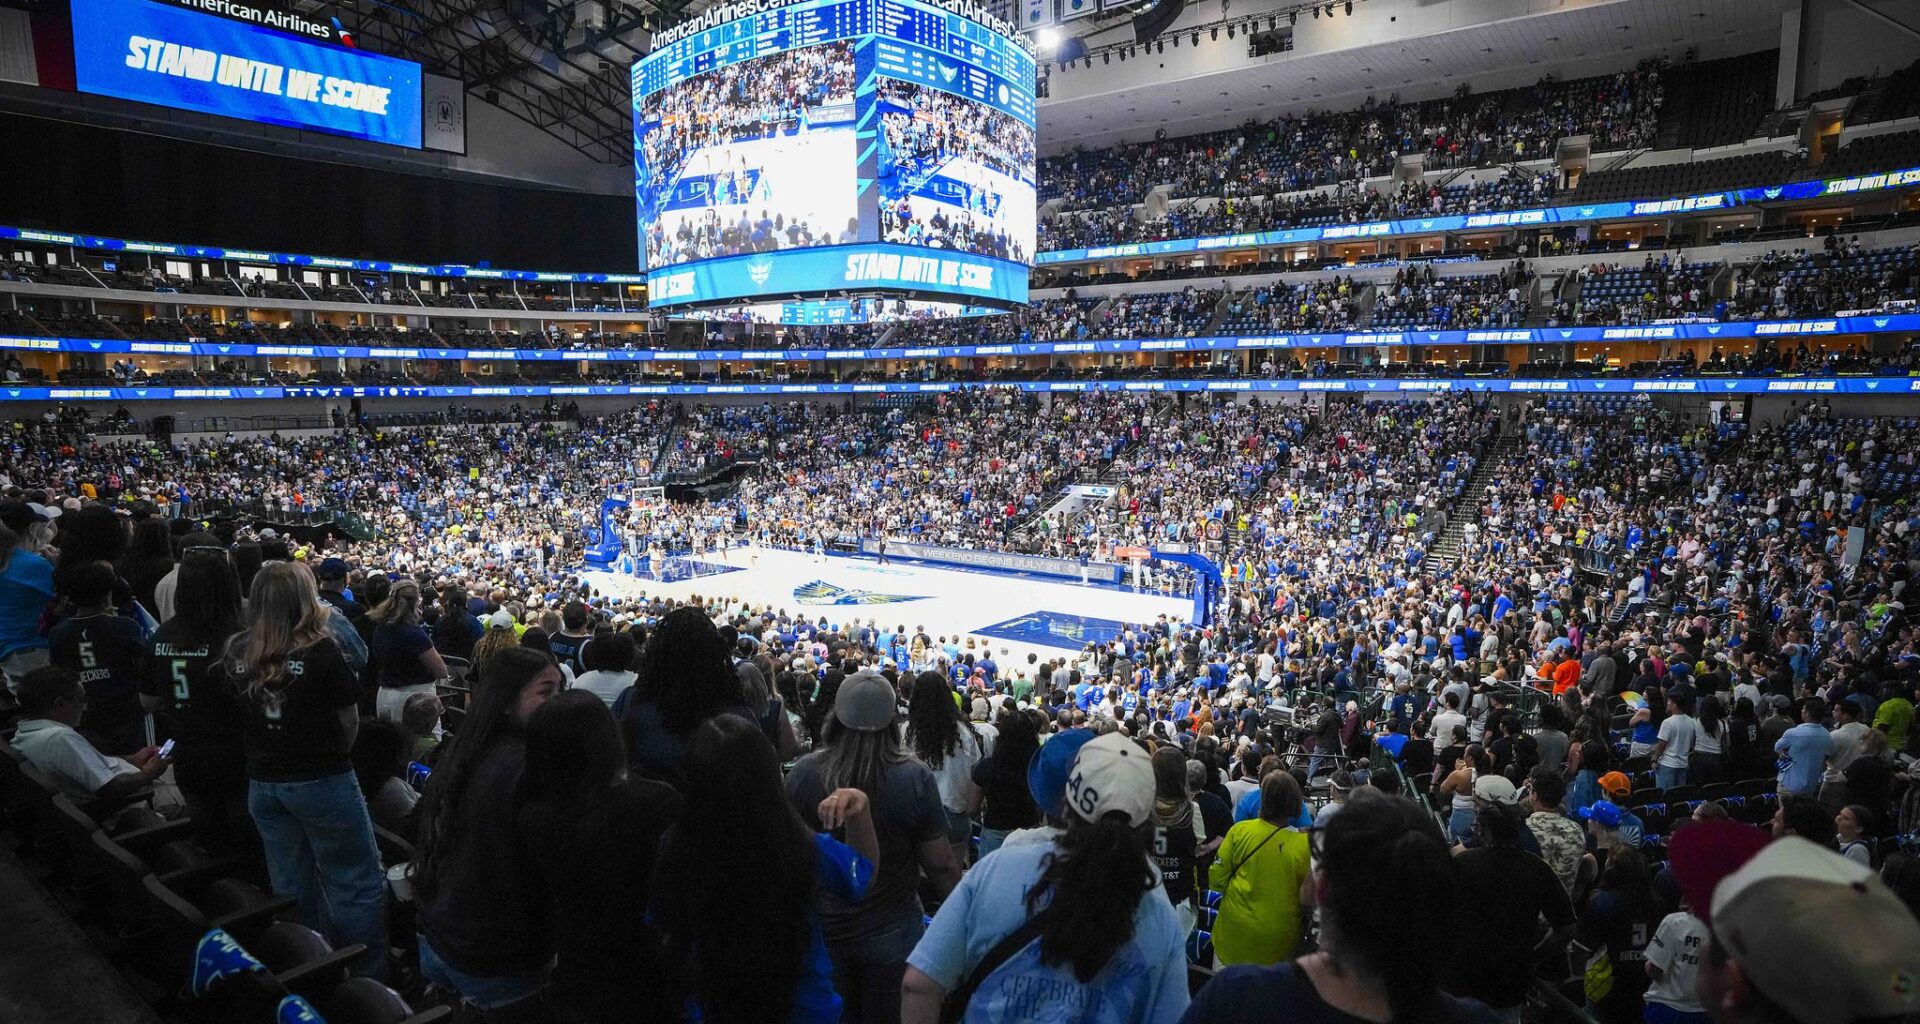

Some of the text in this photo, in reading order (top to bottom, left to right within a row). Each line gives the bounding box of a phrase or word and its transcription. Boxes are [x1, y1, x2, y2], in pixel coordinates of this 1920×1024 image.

[172, 0, 330, 38] merican Airlines
[733, 23, 741, 36] 2
[959, 21, 967, 34] 0
[703, 34, 711, 46] 0
[988, 33, 996, 47] 2
[125, 35, 218, 82] STAND
[216, 54, 283, 95] UNTIL
[286, 68, 323, 103] WE
[322, 77, 391, 115] SCORE
[1827, 179, 1860, 193] STAND
[845, 253, 993, 290] STAND UNTIL WE SCORE
[828, 308, 846, 321] 9:07
[922, 548, 972, 561] WEEKEND
[974, 554, 1013, 567] BEGINS
[1014, 557, 1042, 569] JULY
[79, 642, 96, 667] 5
[172, 660, 189, 699] 5
[957, 668, 964, 677] 5
[1153, 826, 1167, 854] 5
[1000, 974, 1108, 1014] CELEBRATE
